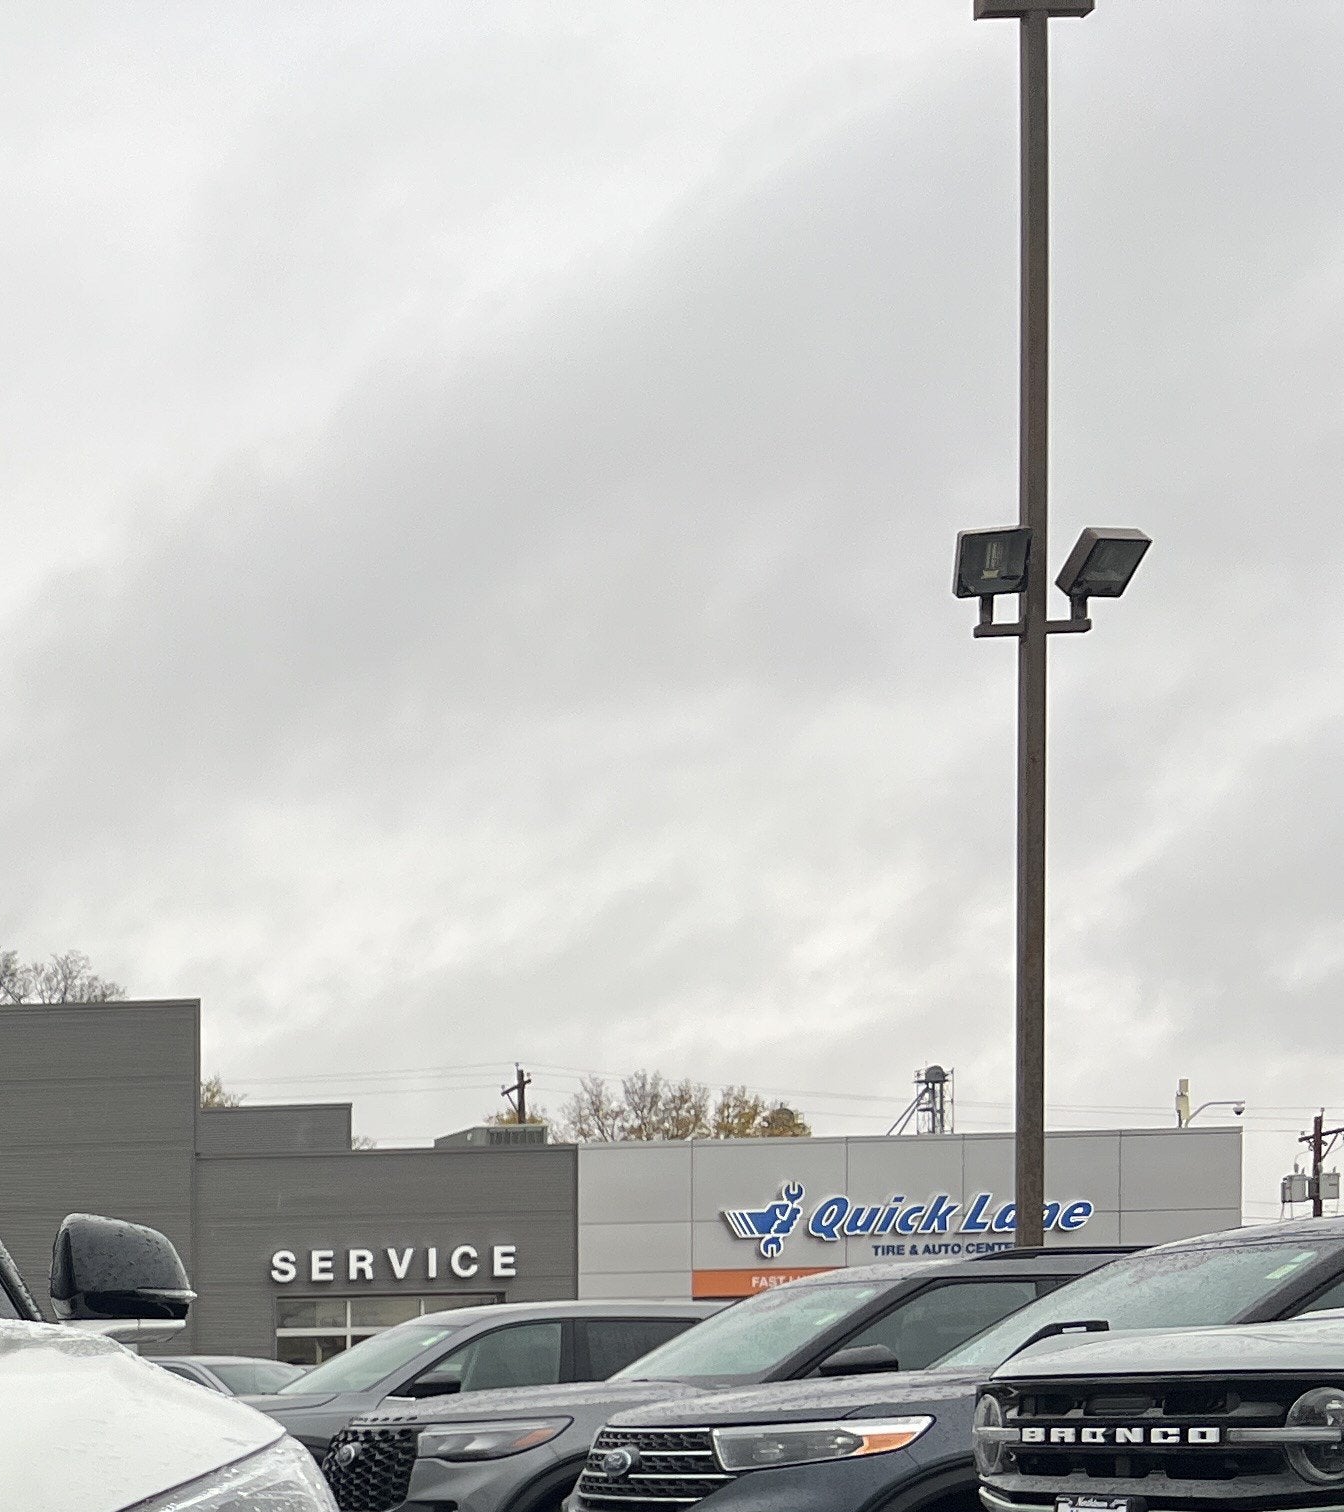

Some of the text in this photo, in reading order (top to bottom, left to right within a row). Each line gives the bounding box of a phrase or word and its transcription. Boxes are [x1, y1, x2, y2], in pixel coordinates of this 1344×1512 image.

[809, 1193, 966, 1241] Quick
[872, 1243, 905, 1257] TIRE
[909, 1244, 919, 1256] &
[922, 1242, 962, 1255] AUTO
[271, 1245, 516, 1283] SERVICE
[1022, 1427, 1220, 1443] BRONCO
